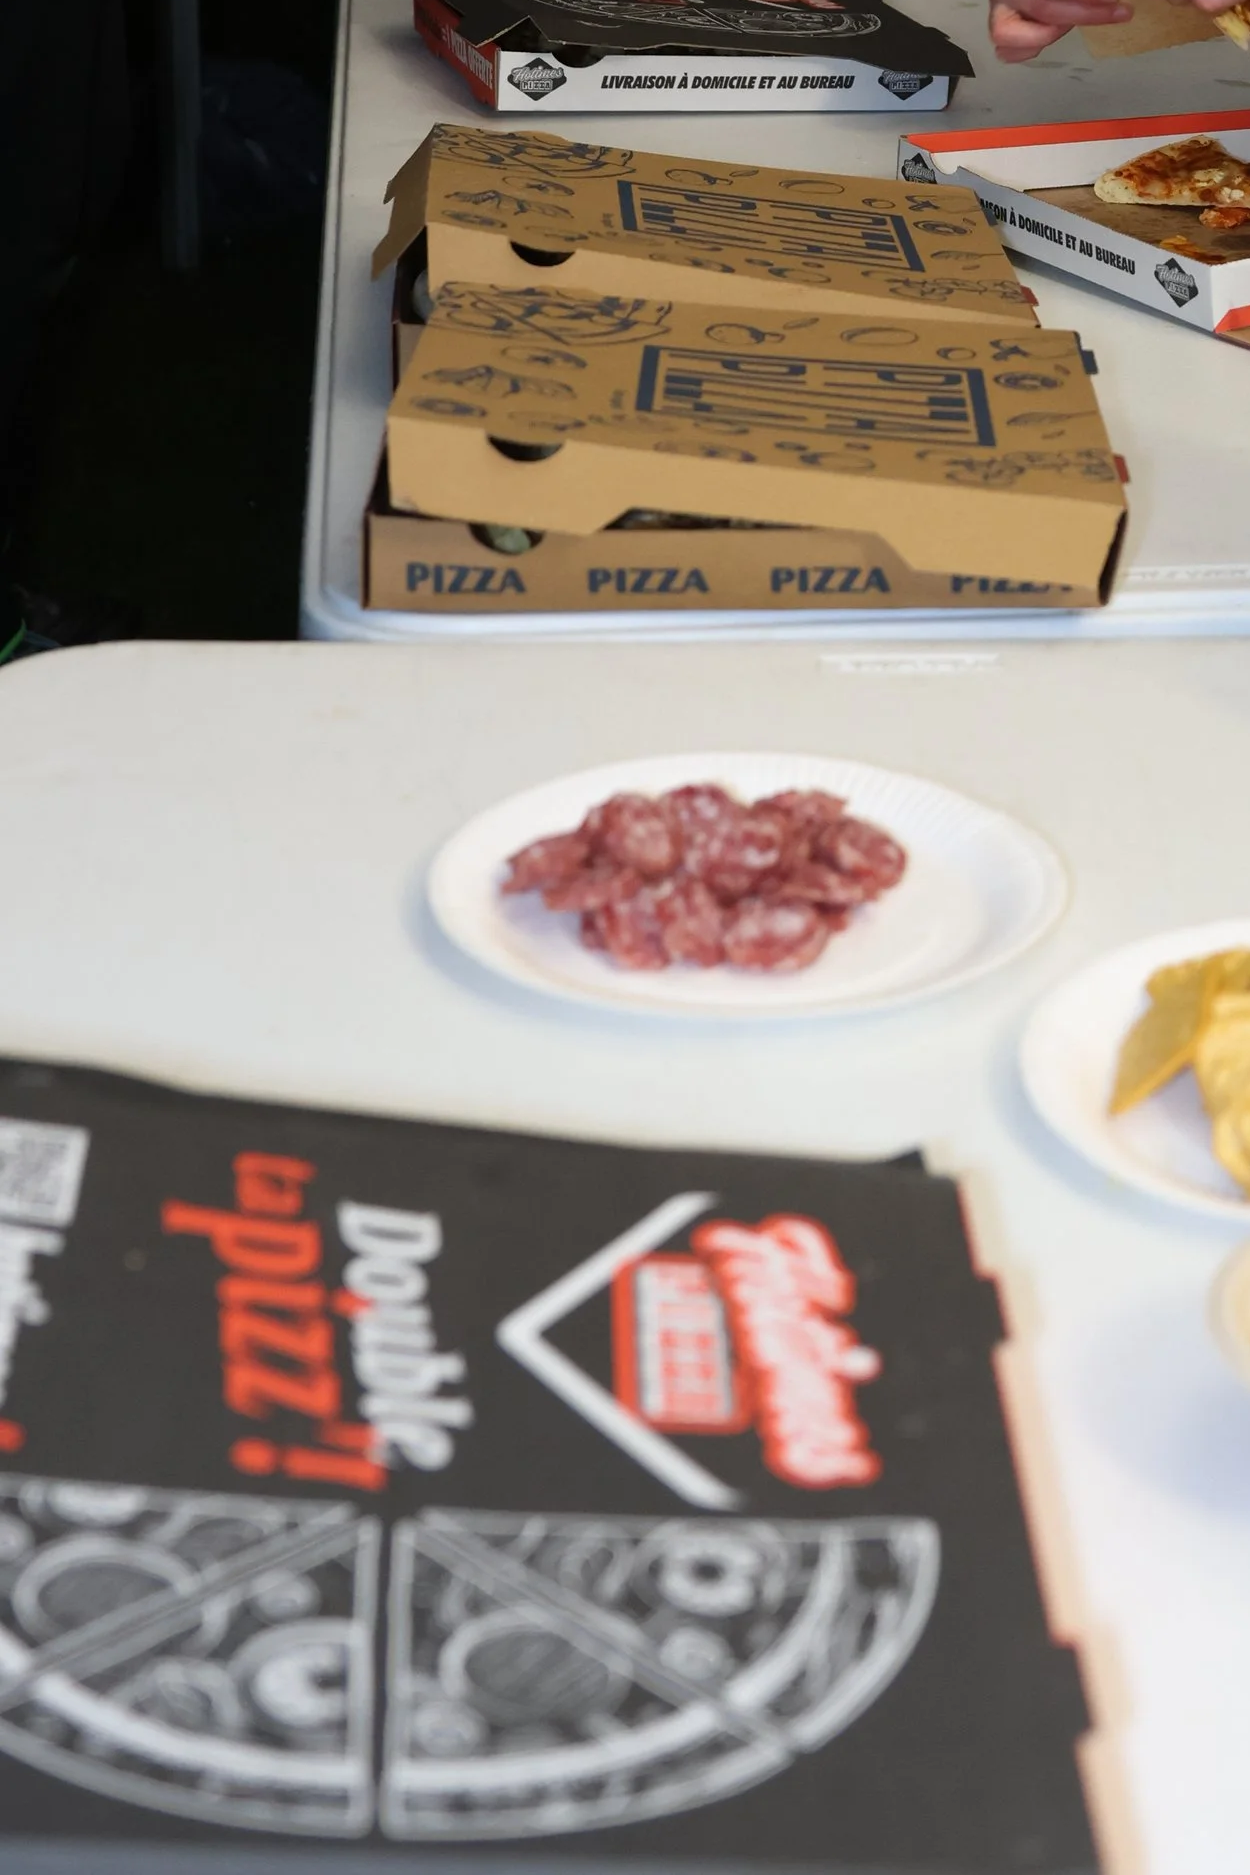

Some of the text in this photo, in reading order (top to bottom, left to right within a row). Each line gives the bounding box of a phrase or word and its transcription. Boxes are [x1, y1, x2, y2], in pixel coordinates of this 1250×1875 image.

[601, 73, 855, 89] LIVRAISON À DOMICILE ET AU BUREAU
[1010, 206, 1017, 225] À
[1018, 214, 1063, 246] DOMICILE
[1066, 234, 1076, 250] ET
[1079, 239, 1093, 258] AU
[1095, 246, 1136, 275] BUREAU
[406, 562, 526, 594] PIZZA
[587, 567, 710, 594] PIZZA
[769, 566, 891, 594] PIZZA
[337, 1198, 473, 1472] Double
